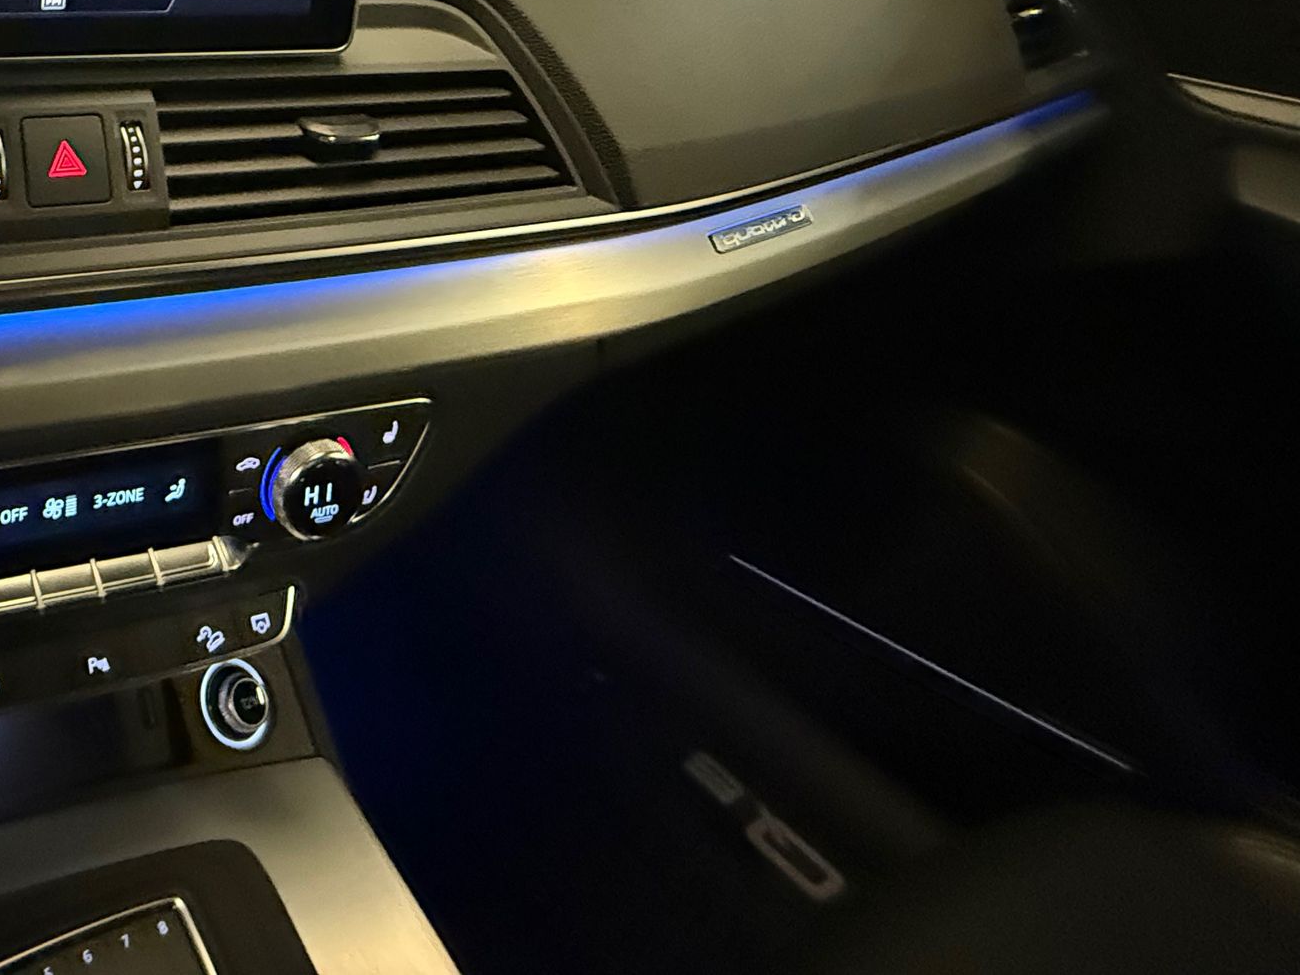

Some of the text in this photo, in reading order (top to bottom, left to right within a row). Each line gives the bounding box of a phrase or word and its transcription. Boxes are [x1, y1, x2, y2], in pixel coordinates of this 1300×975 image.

[93, 486, 145, 510] 3-ZONE
[0, 506, 29, 525] OFF
[232, 512, 255, 526] OFF
[310, 503, 340, 520] AUTO
[82, 949, 93, 964] 6
[120, 933, 130, 948] 7
[157, 920, 169, 935] 8
